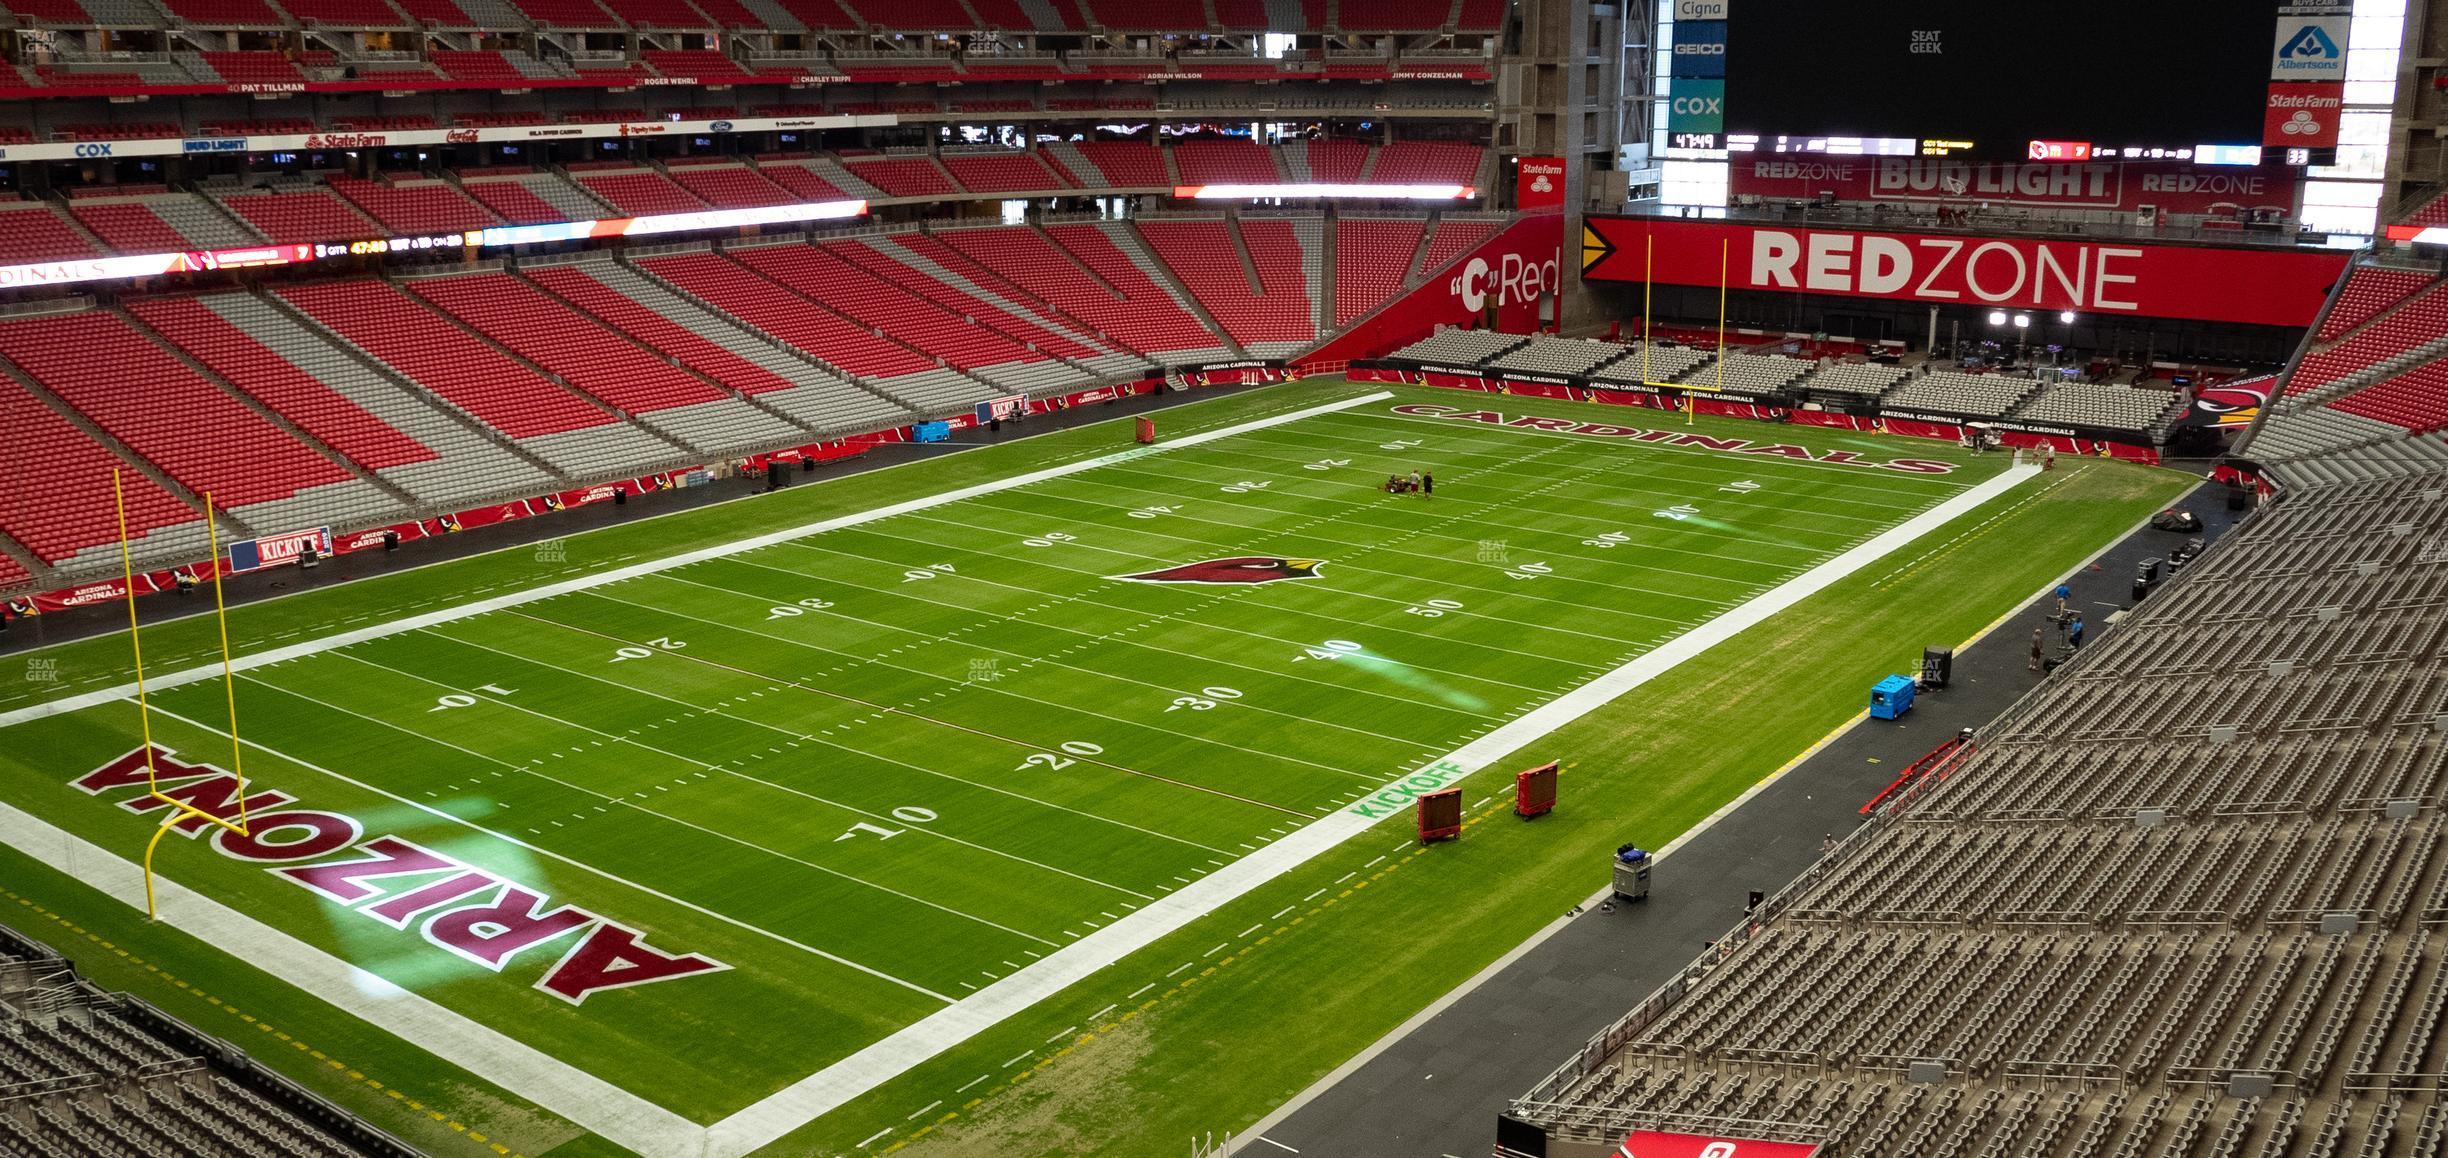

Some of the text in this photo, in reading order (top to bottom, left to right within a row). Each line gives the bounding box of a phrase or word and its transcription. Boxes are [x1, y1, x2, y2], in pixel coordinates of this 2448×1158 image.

[1681, 2, 1721, 18] Cigna
[1674, 44, 1725, 55] GEICO
[2277, 60, 2338, 70] Albertsons
[645, 78, 669, 86] ROGER
[670, 77, 698, 85] WEHRLI
[801, 75, 830, 83] CHARLEY
[831, 75, 851, 83] TRIPPI
[1147, 72, 1174, 80] ADRIAN
[1175, 72, 1202, 80] WILSON
[241, 83, 260, 93] PAT
[263, 82, 305, 92] TILLMAN
[1673, 97, 1721, 115] COX
[185, 139, 246, 152] BUD LIGHT
[1676, 134, 1714, 149] 47:49
[75, 143, 112, 157] COX
[1755, 161, 1853, 182] REDZONE
[1878, 157, 2112, 197] BUD LIGHT
[2142, 174, 2265, 196] REDZONE
[328, 245, 347, 256] QTR
[1498, 246, 1560, 307] Red
[1750, 230, 2143, 310] REDZONE
[1202, 363, 1229, 371] ARIZONA
[1420, 365, 1483, 377] ARIZONA CARDINALS
[1503, 373, 1569, 385] ARIZONA CARDINALS
[1588, 382, 1659, 393] ARIZONA CARDINALS
[1714, 393, 1755, 403] CARDINALS
[1879, 410, 1962, 424] ARIZONA CARDINALS
[2027, 425, 2075, 436] CARDINALS
[1389, 403, 1963, 475] CARDINALS
[580, 491, 615, 503] CARDINA
[1022, 532, 1078, 548] 50
[903, 562, 957, 581] 40
[1504, 562, 1553, 580] 40
[63, 586, 126, 606] CARDINALS
[74, 584, 113, 596] ARIZONA
[769, 597, 835, 618] 30
[1404, 599, 1464, 618] 50
[614, 636, 687, 659] 20
[1304, 639, 1363, 661] 40
[436, 682, 520, 708] 10
[1172, 686, 1244, 712] 30
[1025, 740, 1104, 772] 20
[1348, 761, 1465, 819] KICKOFF
[846, 805, 939, 841] 10
[67, 741, 736, 1007] ARIZONA
